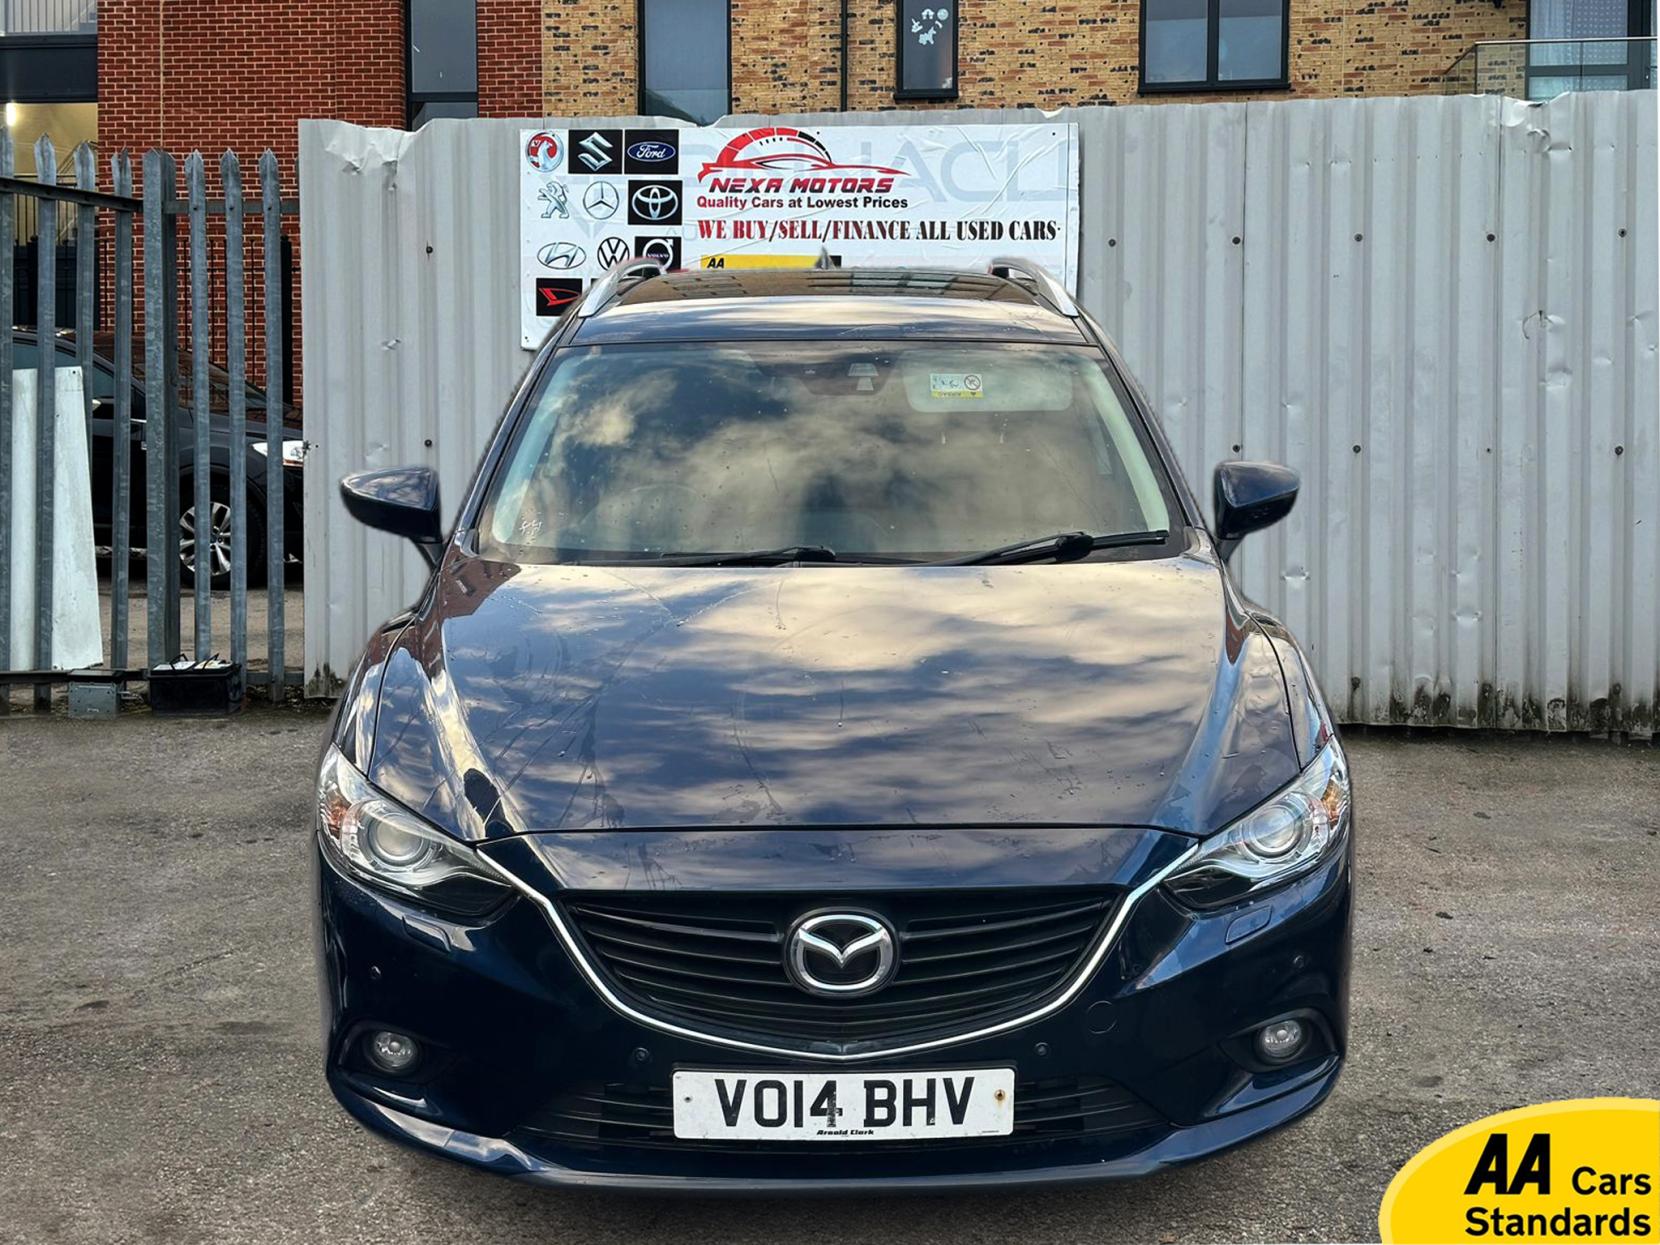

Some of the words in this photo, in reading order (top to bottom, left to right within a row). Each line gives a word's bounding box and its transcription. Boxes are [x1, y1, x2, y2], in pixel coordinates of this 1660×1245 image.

[636, 144, 666, 158] Ford
[708, 177, 784, 194] NEXA
[789, 177, 895, 194] MOTORS
[697, 195, 747, 210] Quality
[752, 195, 784, 209] Cars
[788, 196, 802, 209] at
[807, 195, 859, 208] Lowest
[863, 195, 908, 208] Prices
[697, 219, 727, 240] WE
[916, 219, 951, 240] ALL
[956, 219, 1004, 240] USED
[1009, 219, 1057, 240] CARS
[706, 257, 725, 268] AA
[714, 1079, 843, 1127] VO14
[863, 1076, 975, 1127] BHV
